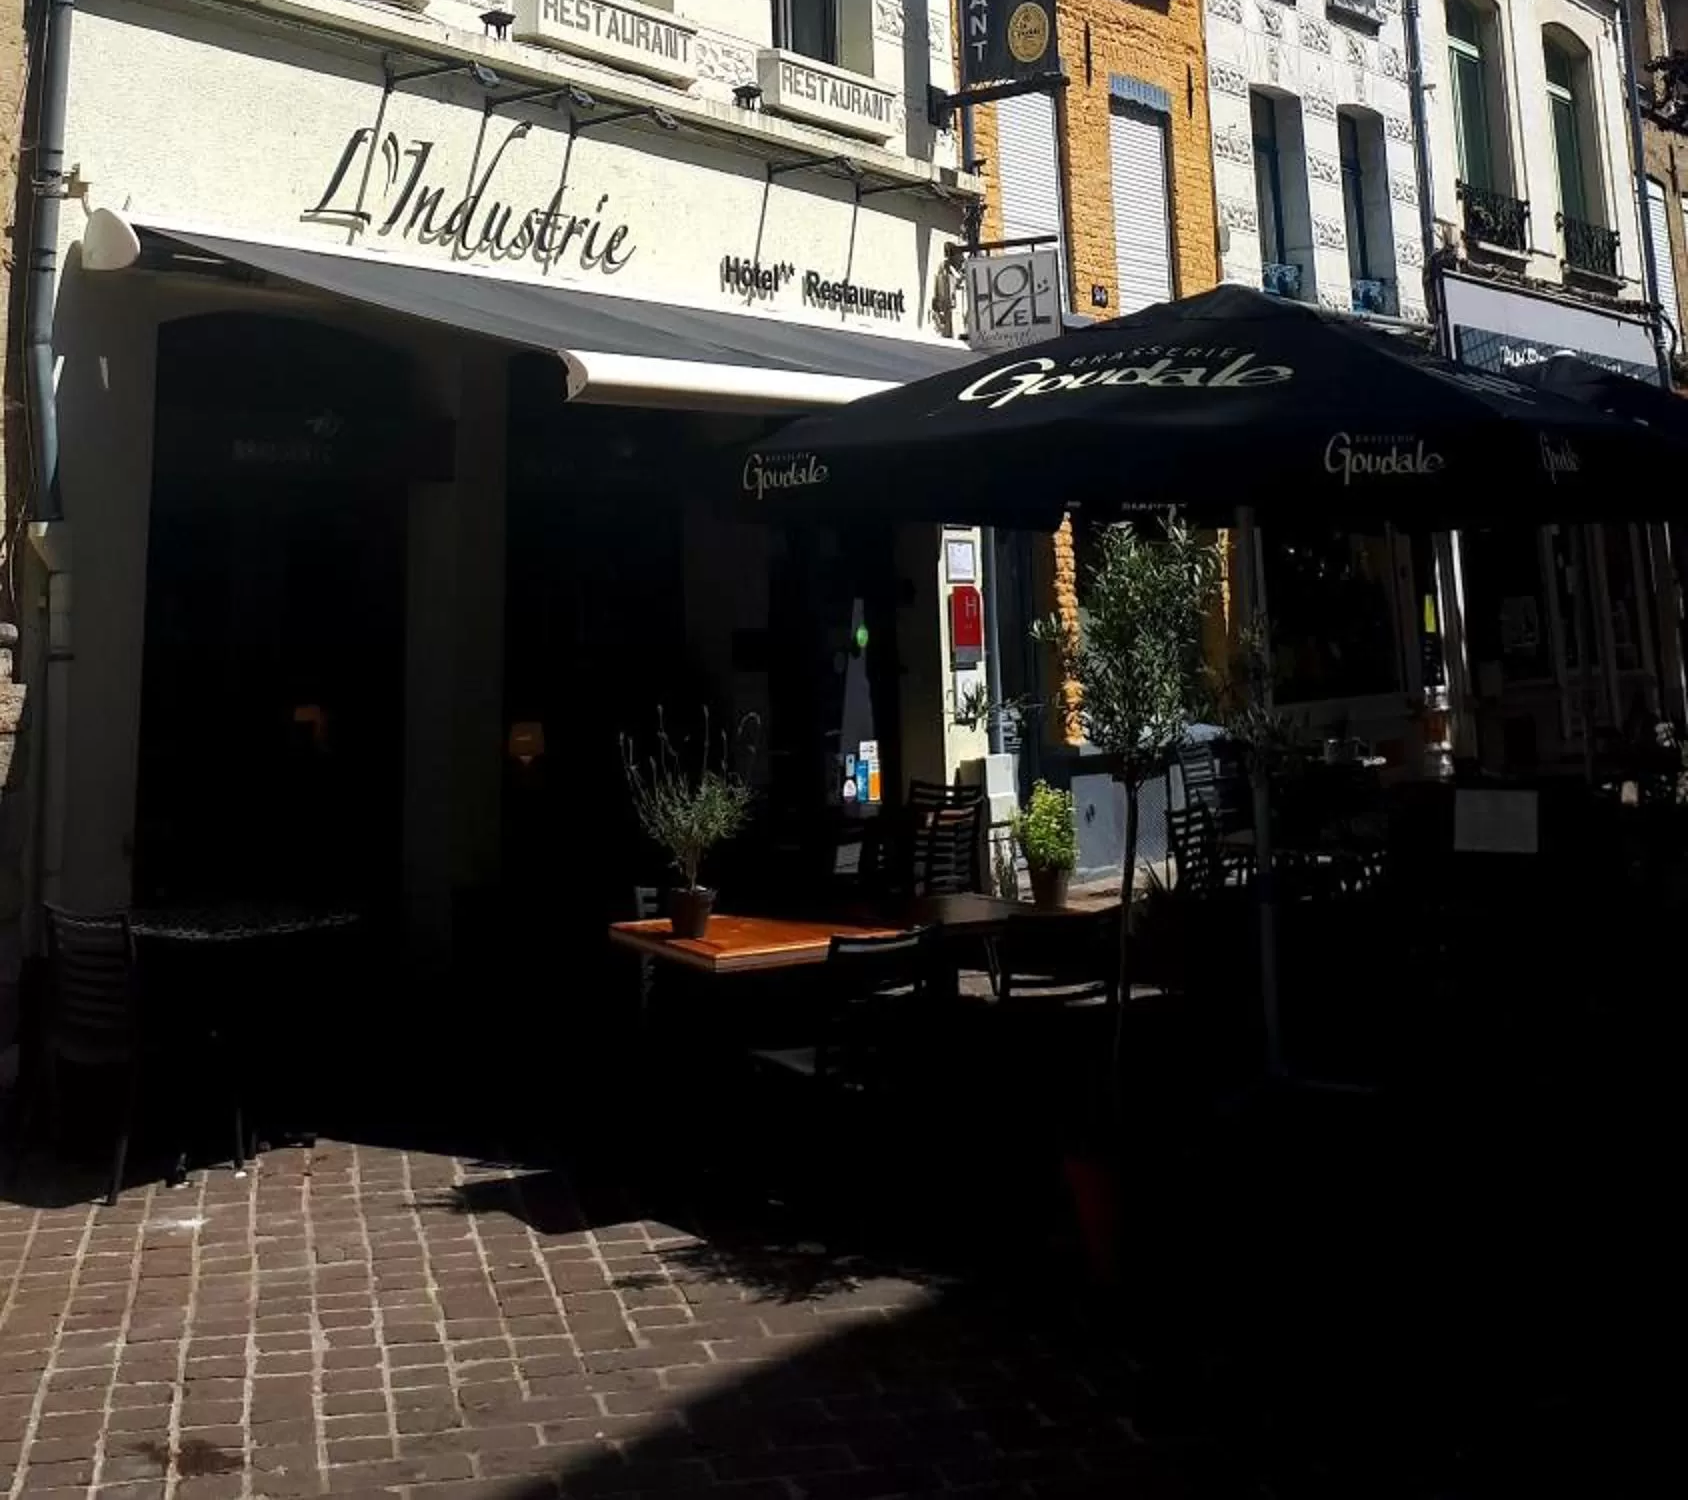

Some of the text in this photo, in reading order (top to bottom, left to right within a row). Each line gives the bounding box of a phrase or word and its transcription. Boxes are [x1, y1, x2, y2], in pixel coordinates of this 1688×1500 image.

[781, 63, 893, 123] RESTAURANT
[302, 121, 637, 266] L'Industrie
[805, 269, 906, 313] Restaurant
[957, 353, 1295, 408] Goudale
[1069, 344, 1237, 368] BRASSERIE
[742, 452, 829, 500] Goudale
[1323, 430, 1447, 486] Goudale
